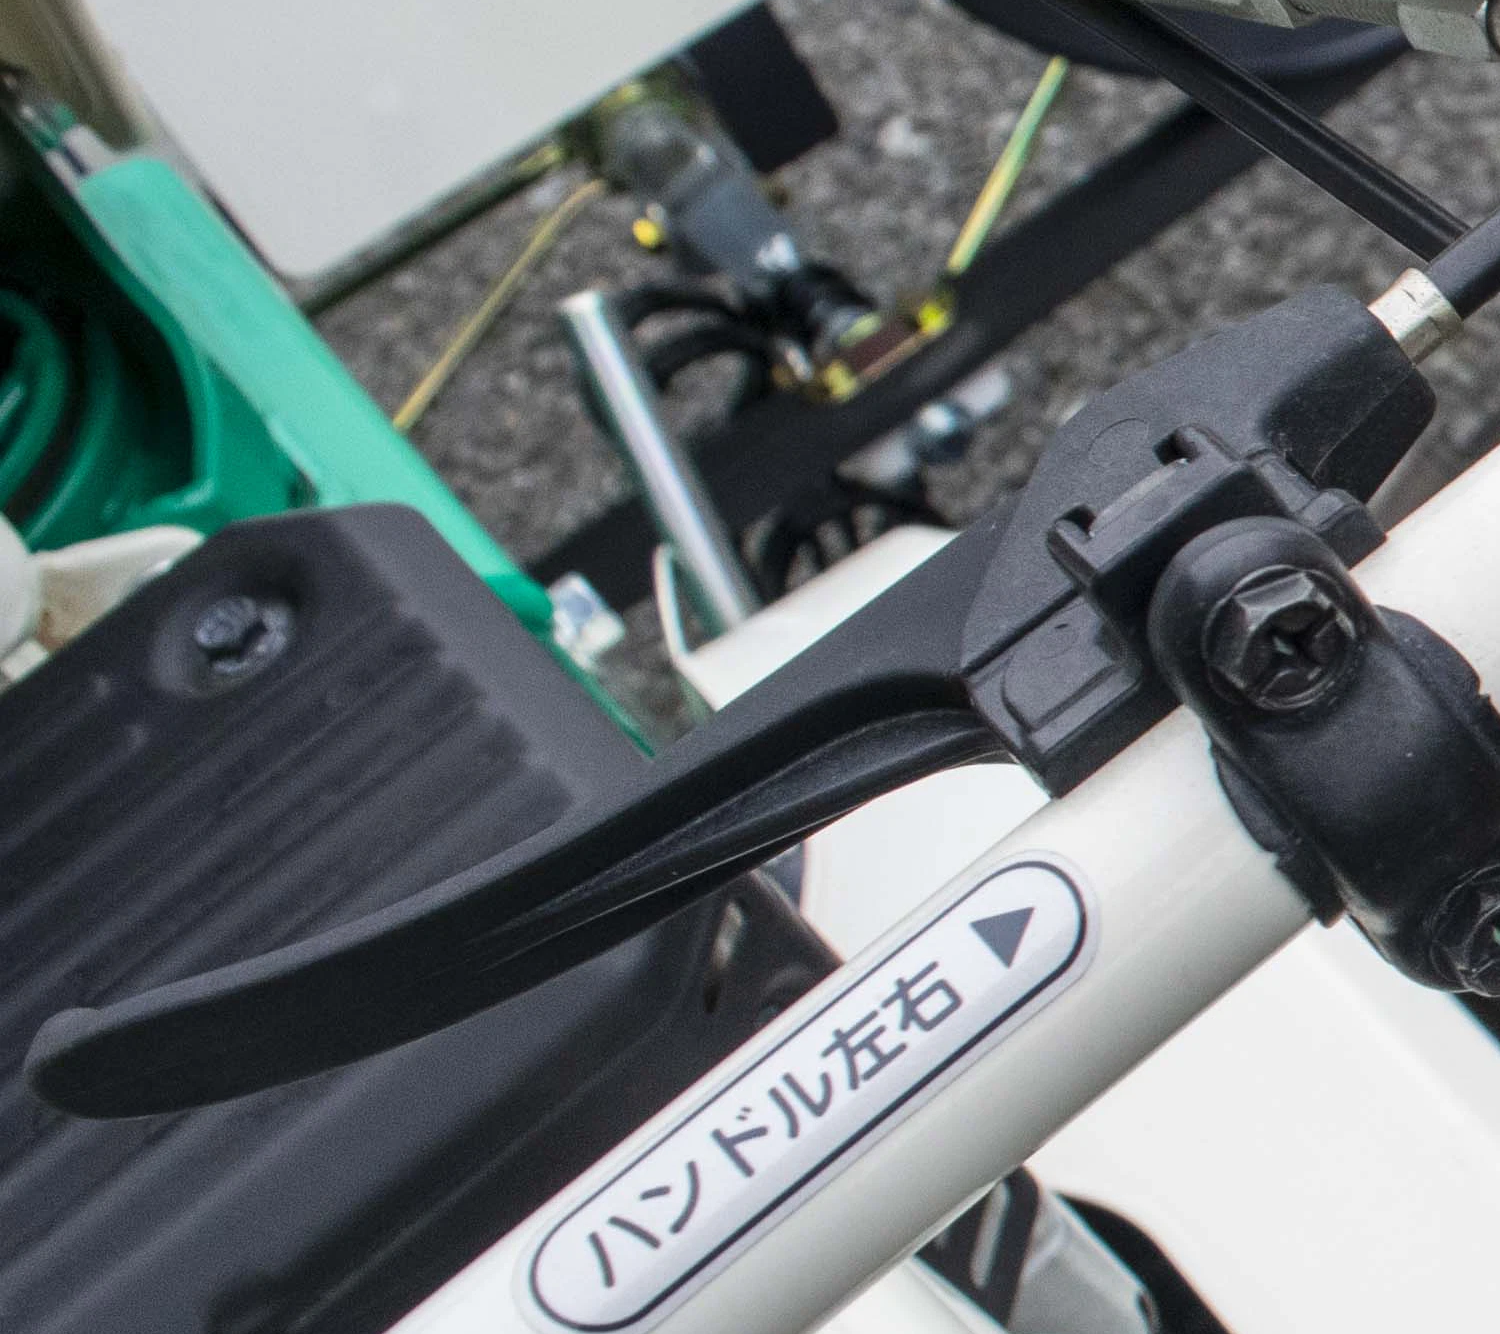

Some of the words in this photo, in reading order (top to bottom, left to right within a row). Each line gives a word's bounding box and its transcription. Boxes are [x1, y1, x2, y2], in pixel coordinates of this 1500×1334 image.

[586, 960, 964, 1288] ハンドル左右
